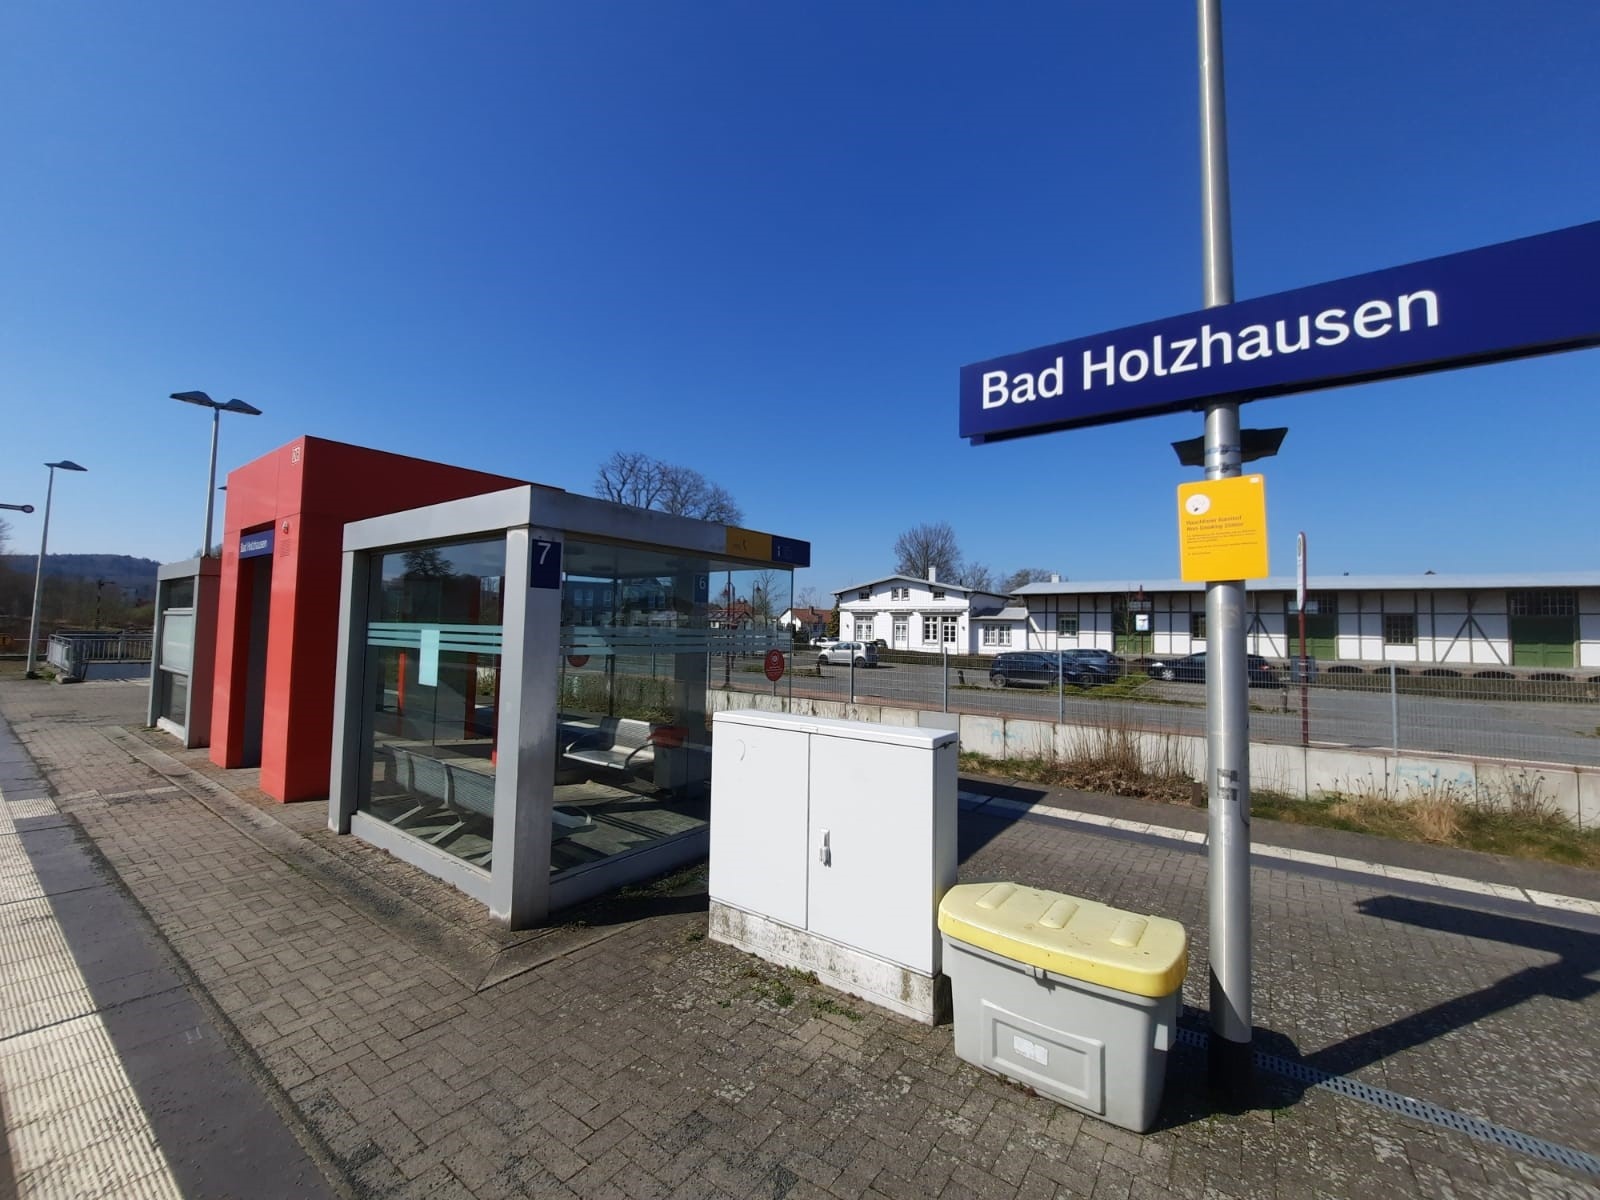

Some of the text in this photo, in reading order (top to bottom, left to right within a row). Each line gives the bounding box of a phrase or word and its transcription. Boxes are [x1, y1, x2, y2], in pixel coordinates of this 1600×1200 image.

[982, 290, 1439, 410] Bad Holzhausen
[537, 542, 552, 565] 7
[699, 576, 707, 590] 6
